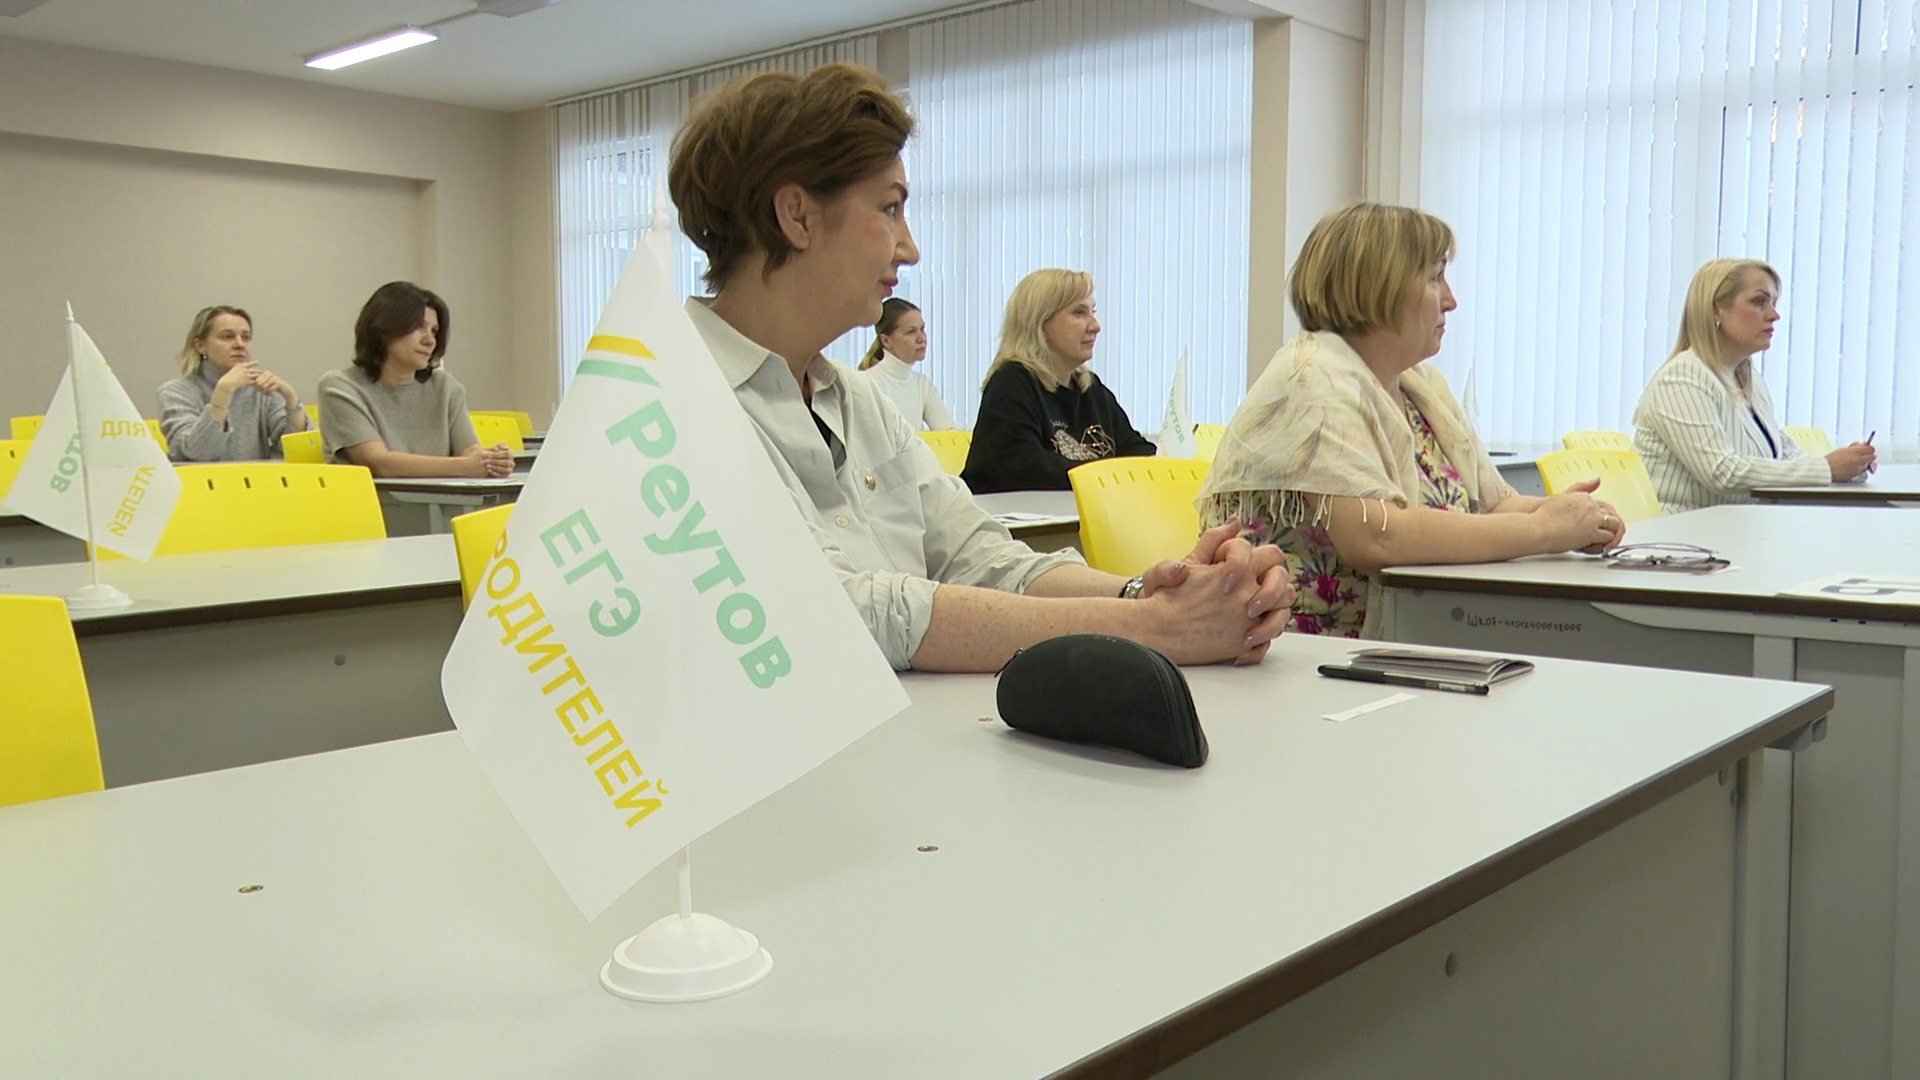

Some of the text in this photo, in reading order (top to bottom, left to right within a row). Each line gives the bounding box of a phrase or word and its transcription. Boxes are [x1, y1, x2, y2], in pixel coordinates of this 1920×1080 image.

[101, 420, 147, 439] ДЛЯ
[539, 508, 642, 637] ЕГЭ
[605, 399, 793, 690] Реутов
